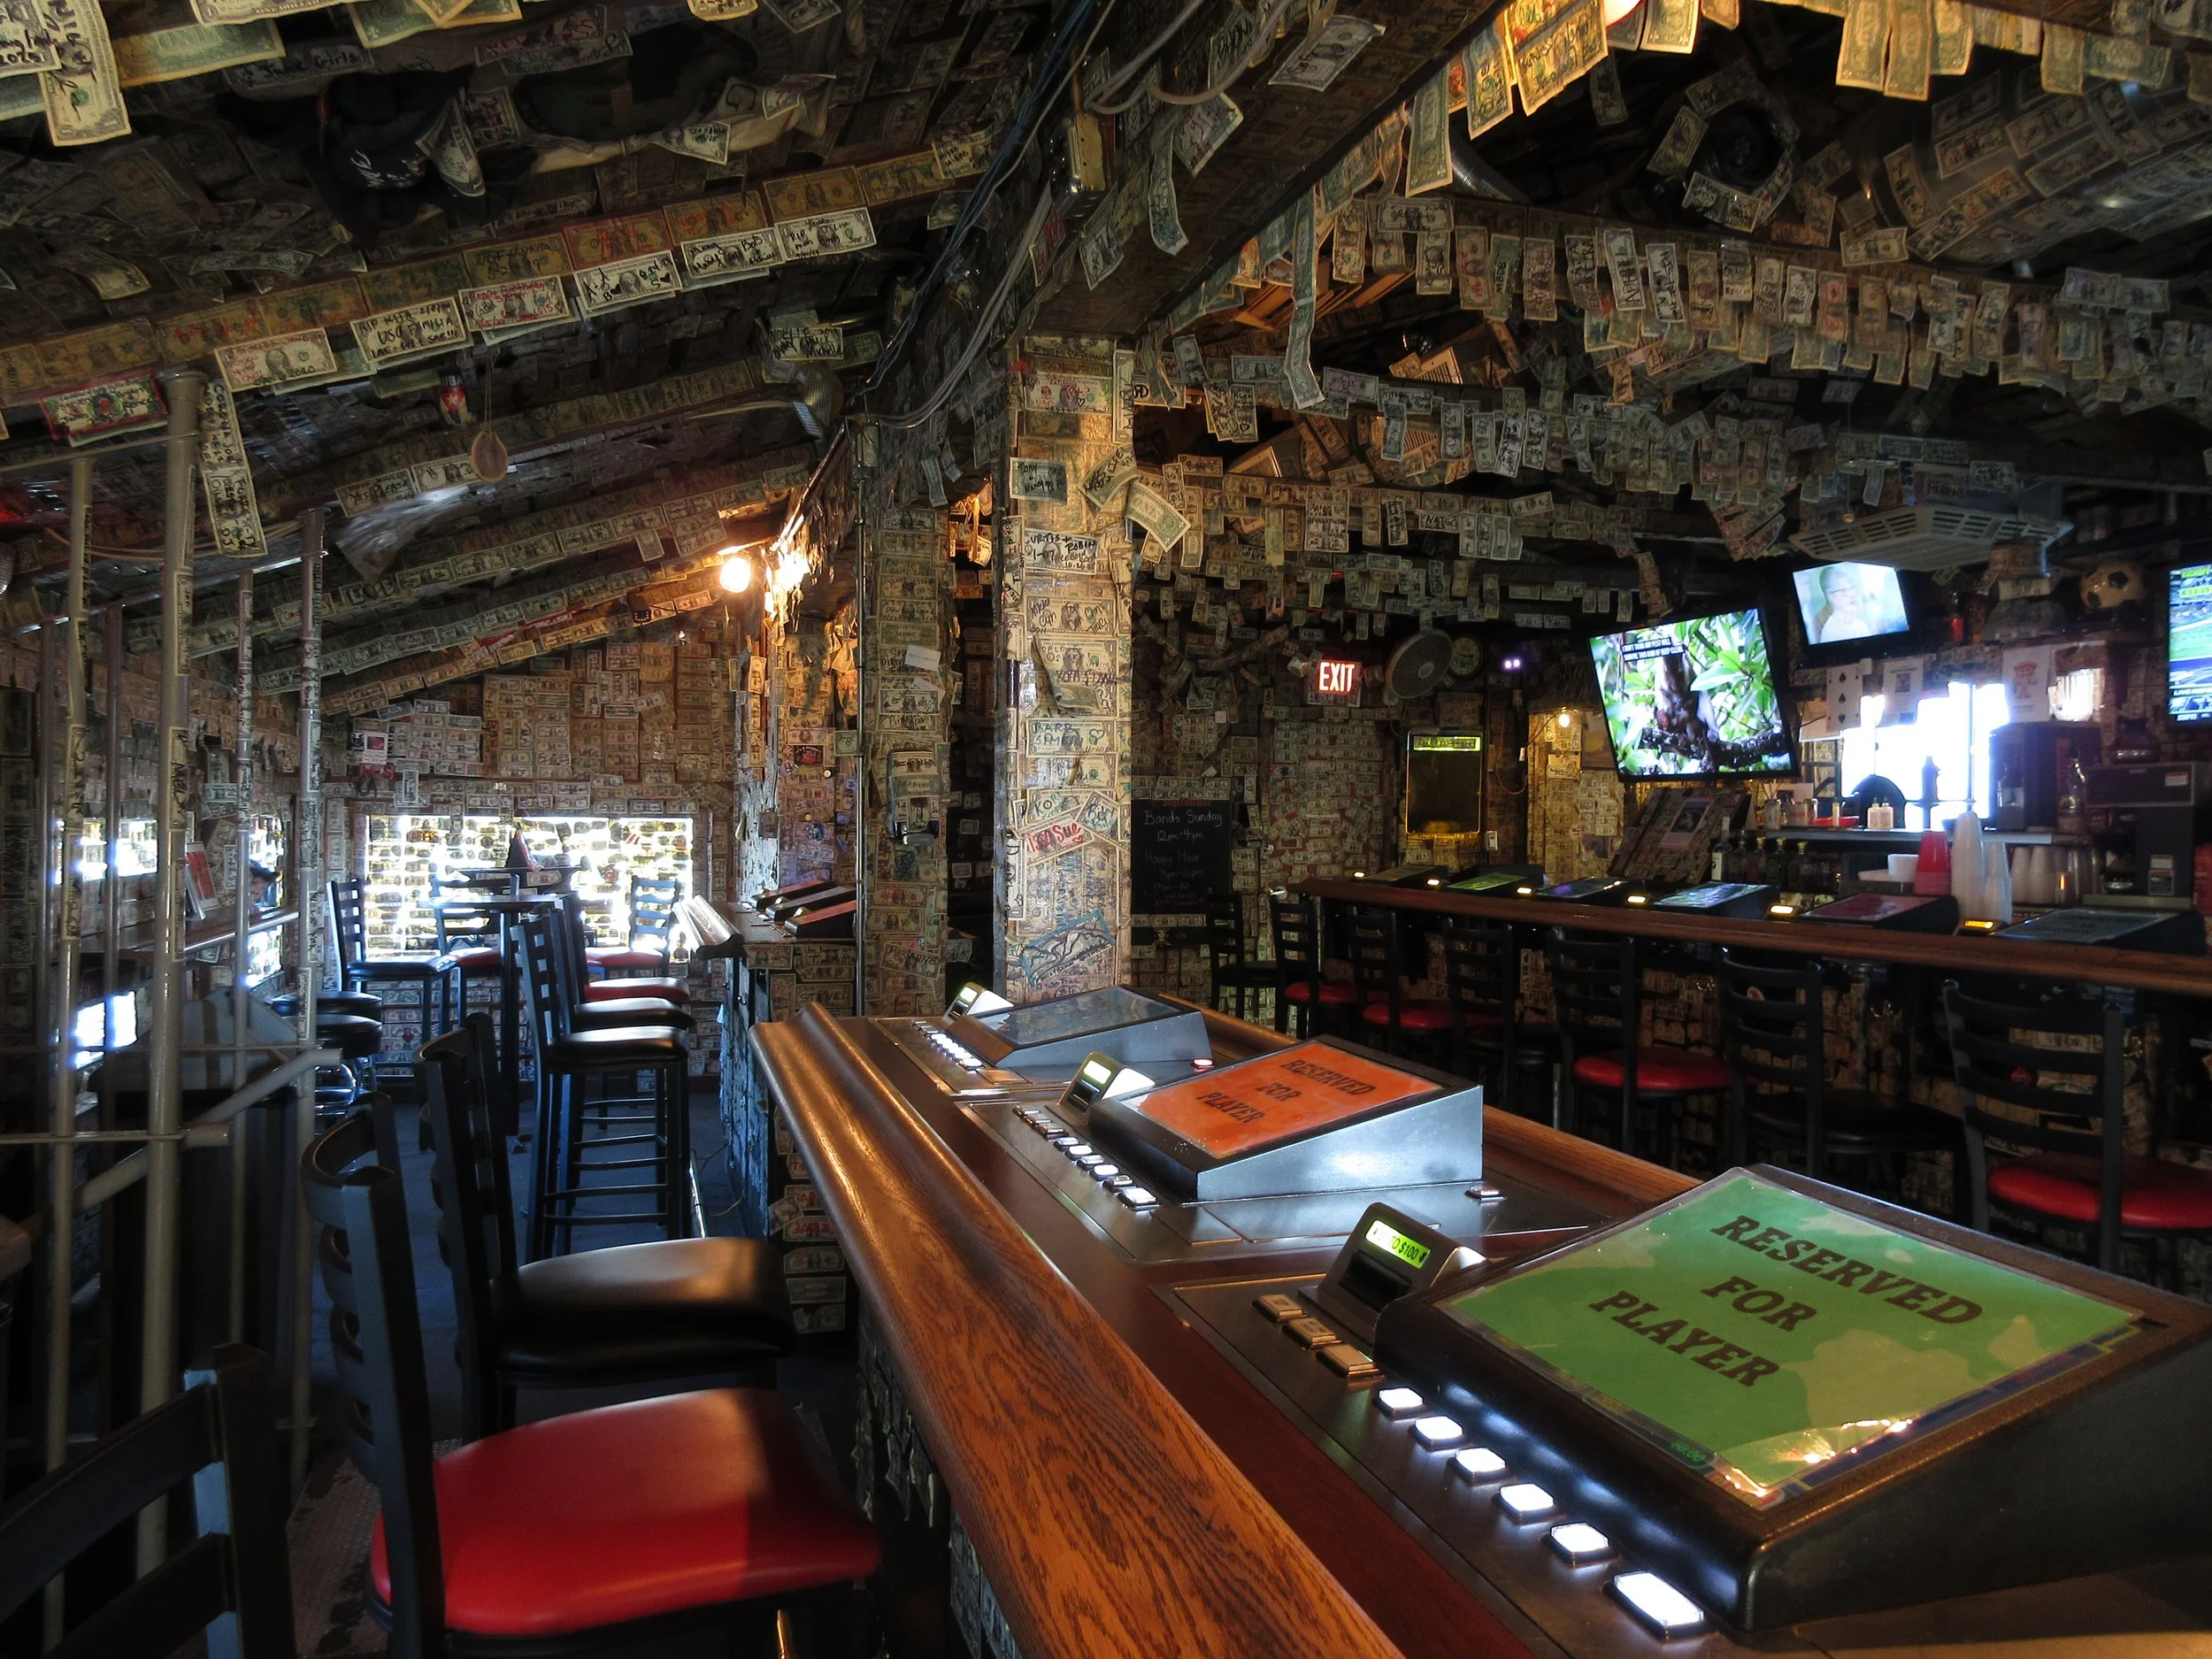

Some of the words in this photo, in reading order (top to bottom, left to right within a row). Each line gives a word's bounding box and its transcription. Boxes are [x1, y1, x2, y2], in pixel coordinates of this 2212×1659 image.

[1318, 661, 1355, 693] EXIT
[1142, 809, 1181, 826] Bands
[1185, 809, 1224, 827] Sunday
[1256, 1081, 1302, 1105] FOR
[1280, 1056, 1377, 1097] RESERVED
[1195, 1090, 1267, 1125] PLAYER
[1709, 1214, 1984, 1327] RESERVED
[1701, 1275, 1817, 1333] FOR
[1588, 1289, 1781, 1388] PLAYER
